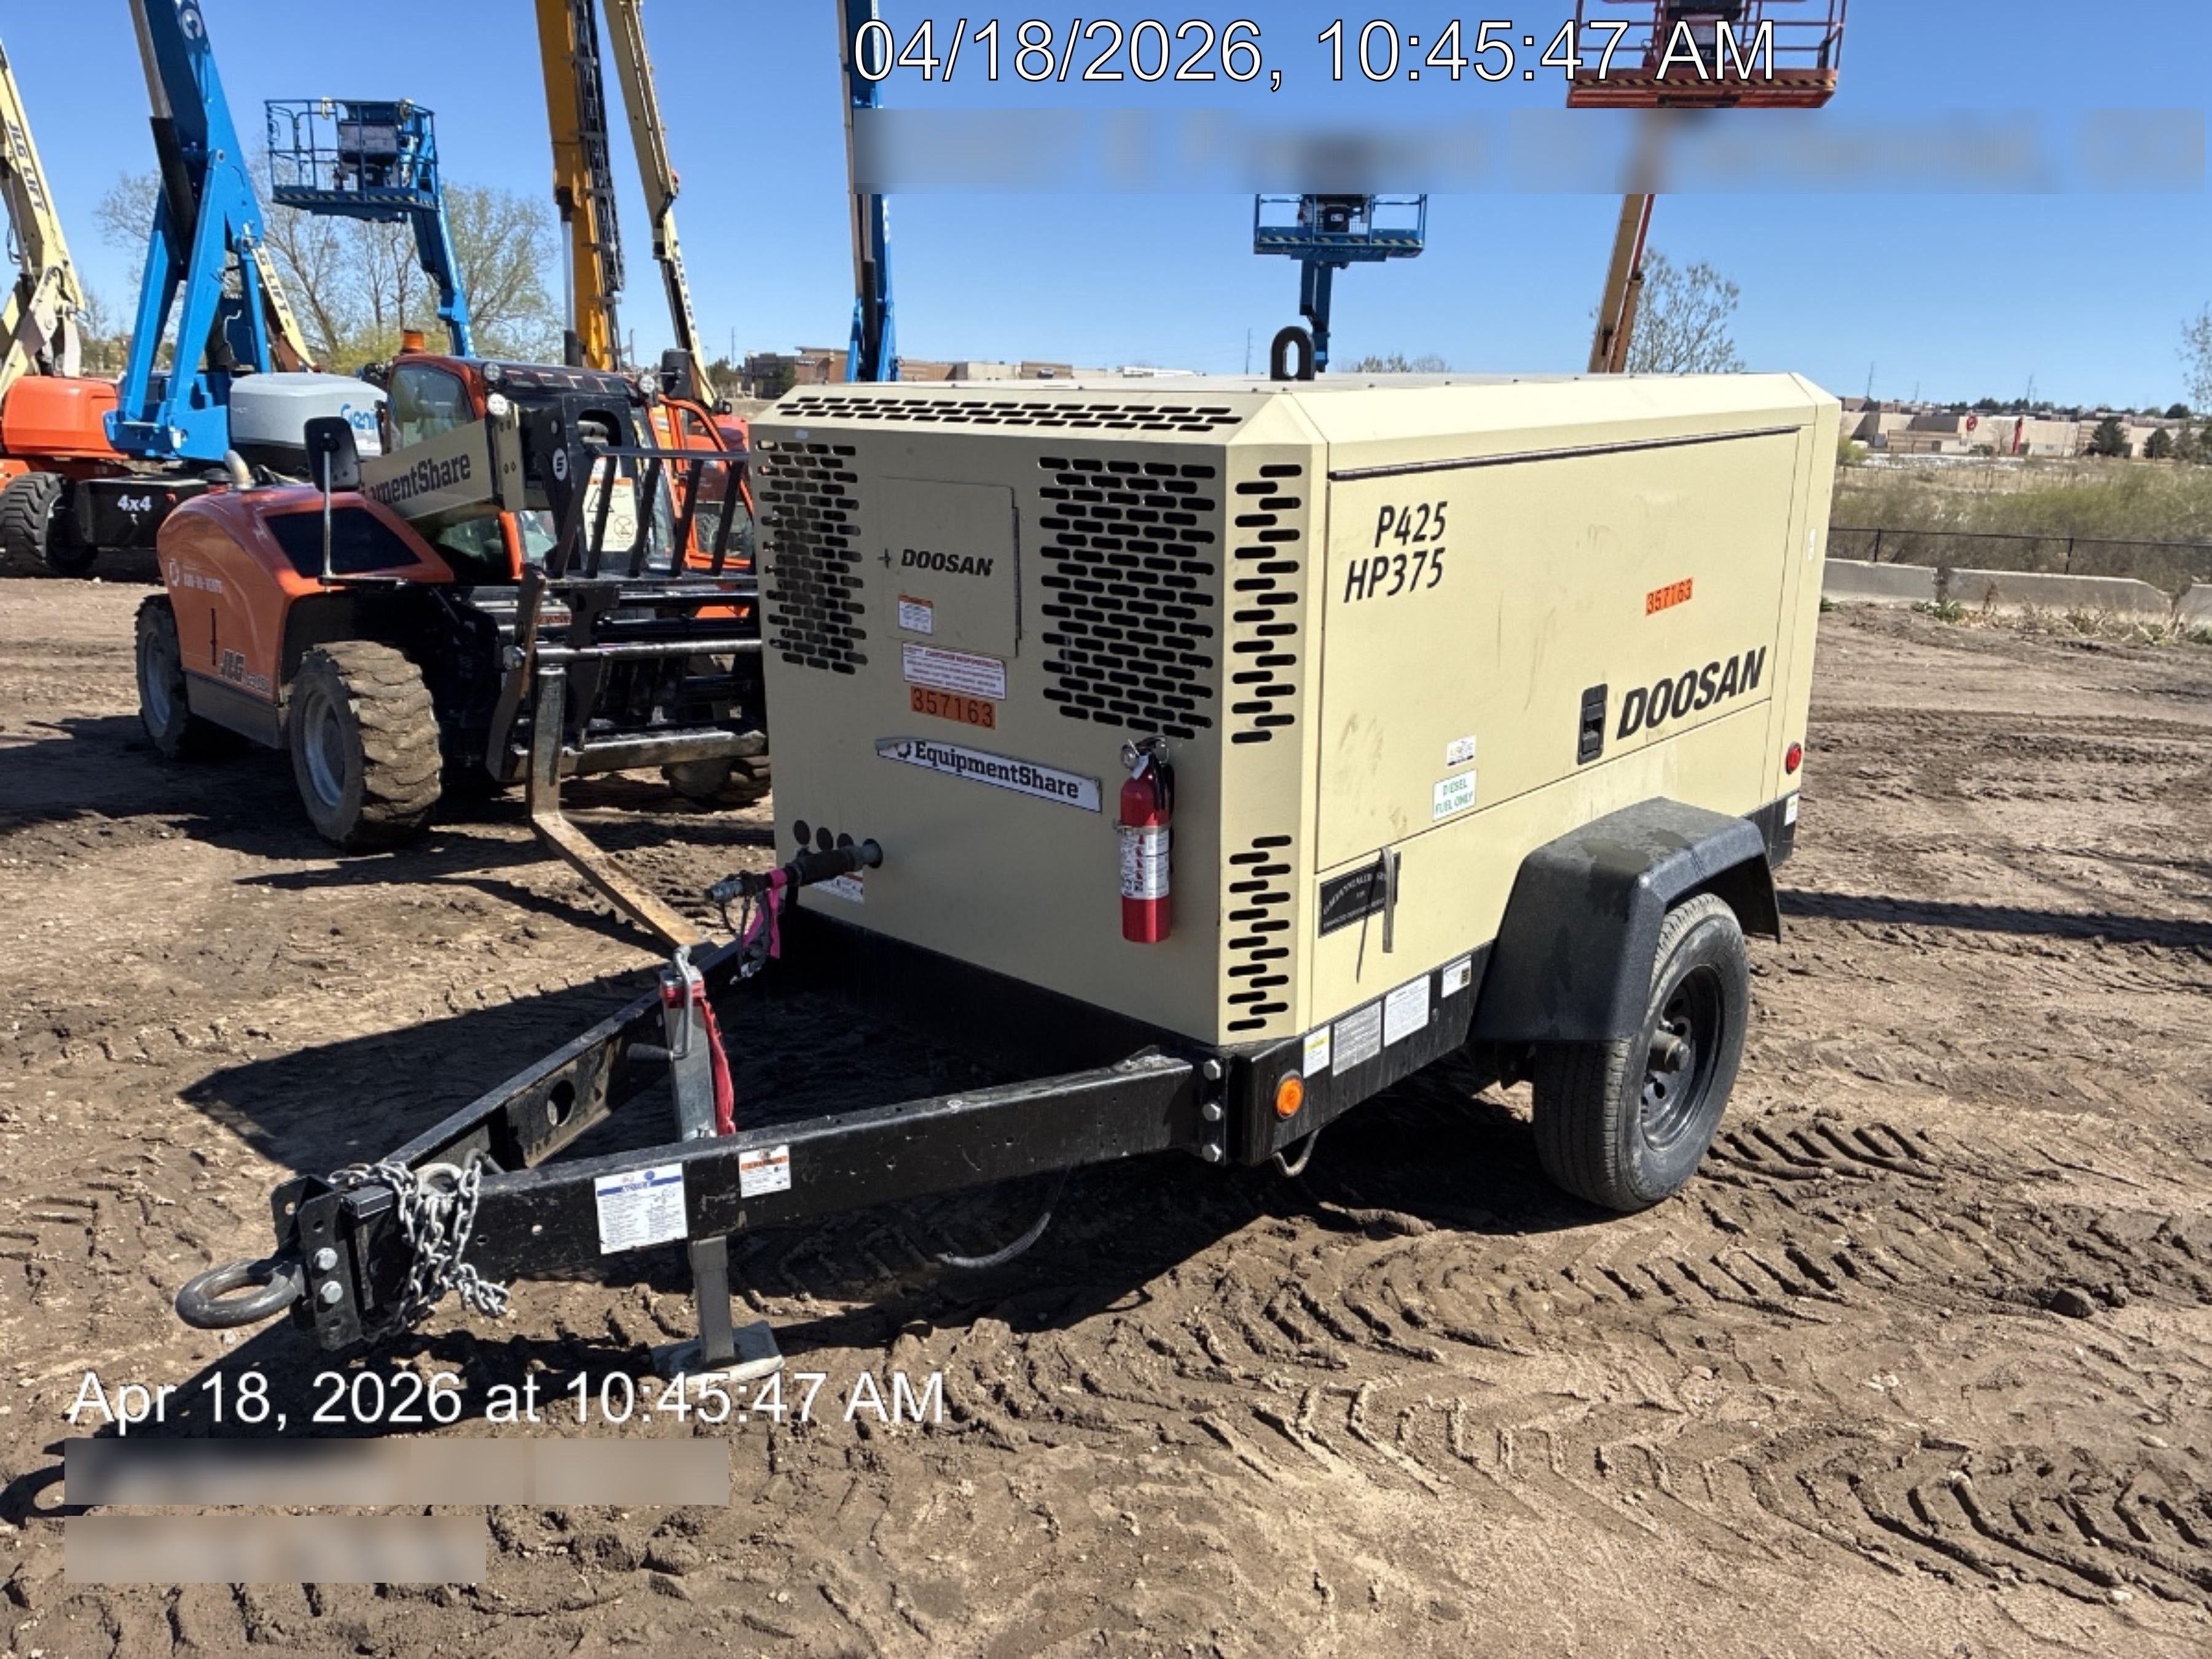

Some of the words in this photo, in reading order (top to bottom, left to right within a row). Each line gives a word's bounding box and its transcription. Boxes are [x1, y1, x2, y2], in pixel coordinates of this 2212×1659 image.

[22, 166, 45, 210] LIFT
[341, 404, 376, 429] Geni
[370, 453, 471, 504] mentShare
[117, 493, 152, 511] 4x4
[1375, 501, 1448, 548] P425
[901, 549, 994, 576] DOOSAN
[1344, 547, 1446, 603] HP375
[1646, 578, 1692, 614] 357163
[913, 688, 993, 728] 357163
[1617, 645, 1767, 740] DOOSAN
[915, 740, 1080, 799] EquipmentShare
[1443, 778, 1468, 796] DIESEL
[1435, 799, 1453, 815] FUEL
[1454, 791, 1473, 808] ONLY
